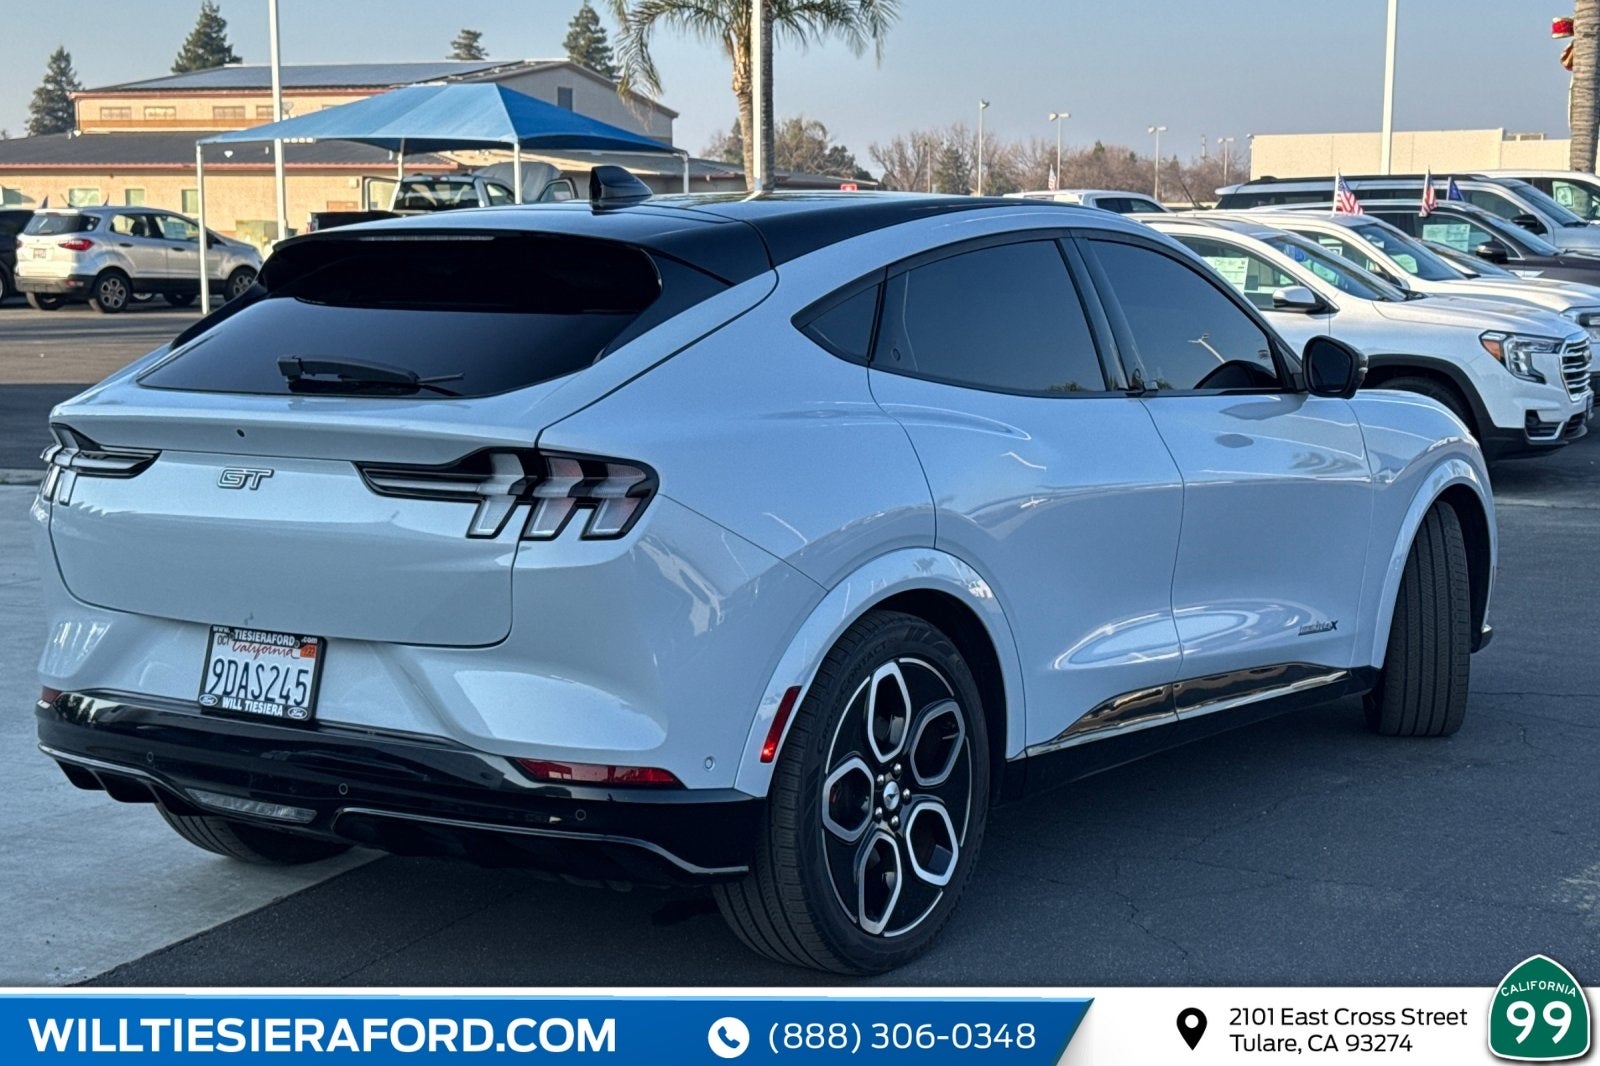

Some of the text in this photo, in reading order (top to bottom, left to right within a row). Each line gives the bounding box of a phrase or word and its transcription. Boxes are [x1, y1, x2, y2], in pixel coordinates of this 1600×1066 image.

[217, 467, 274, 490] GT
[234, 630, 296, 646] TIESIERAFORD
[208, 657, 309, 706] 9DAS245
[222, 697, 283, 716] WILL TIESIERA
